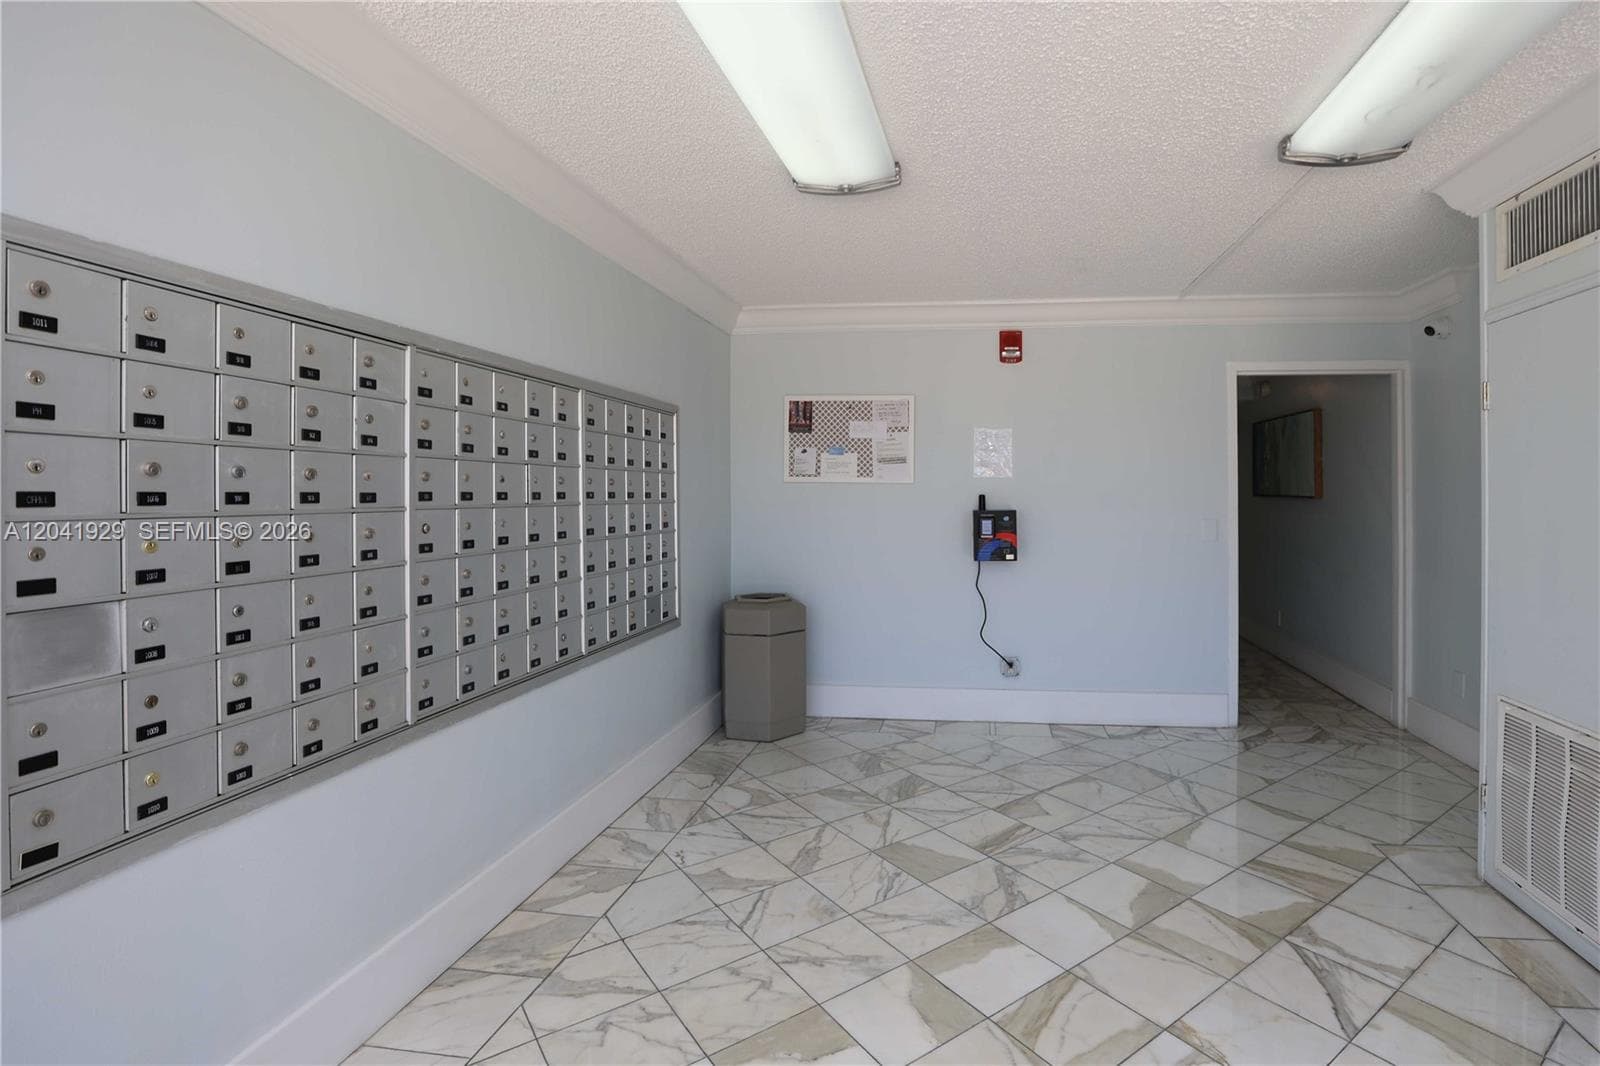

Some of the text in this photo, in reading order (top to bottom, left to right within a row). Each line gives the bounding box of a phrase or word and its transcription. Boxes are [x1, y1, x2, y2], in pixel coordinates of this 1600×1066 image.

[32, 317, 48, 328] 1011
[146, 726, 159, 736] 1009
[147, 803, 161, 814] 1010
